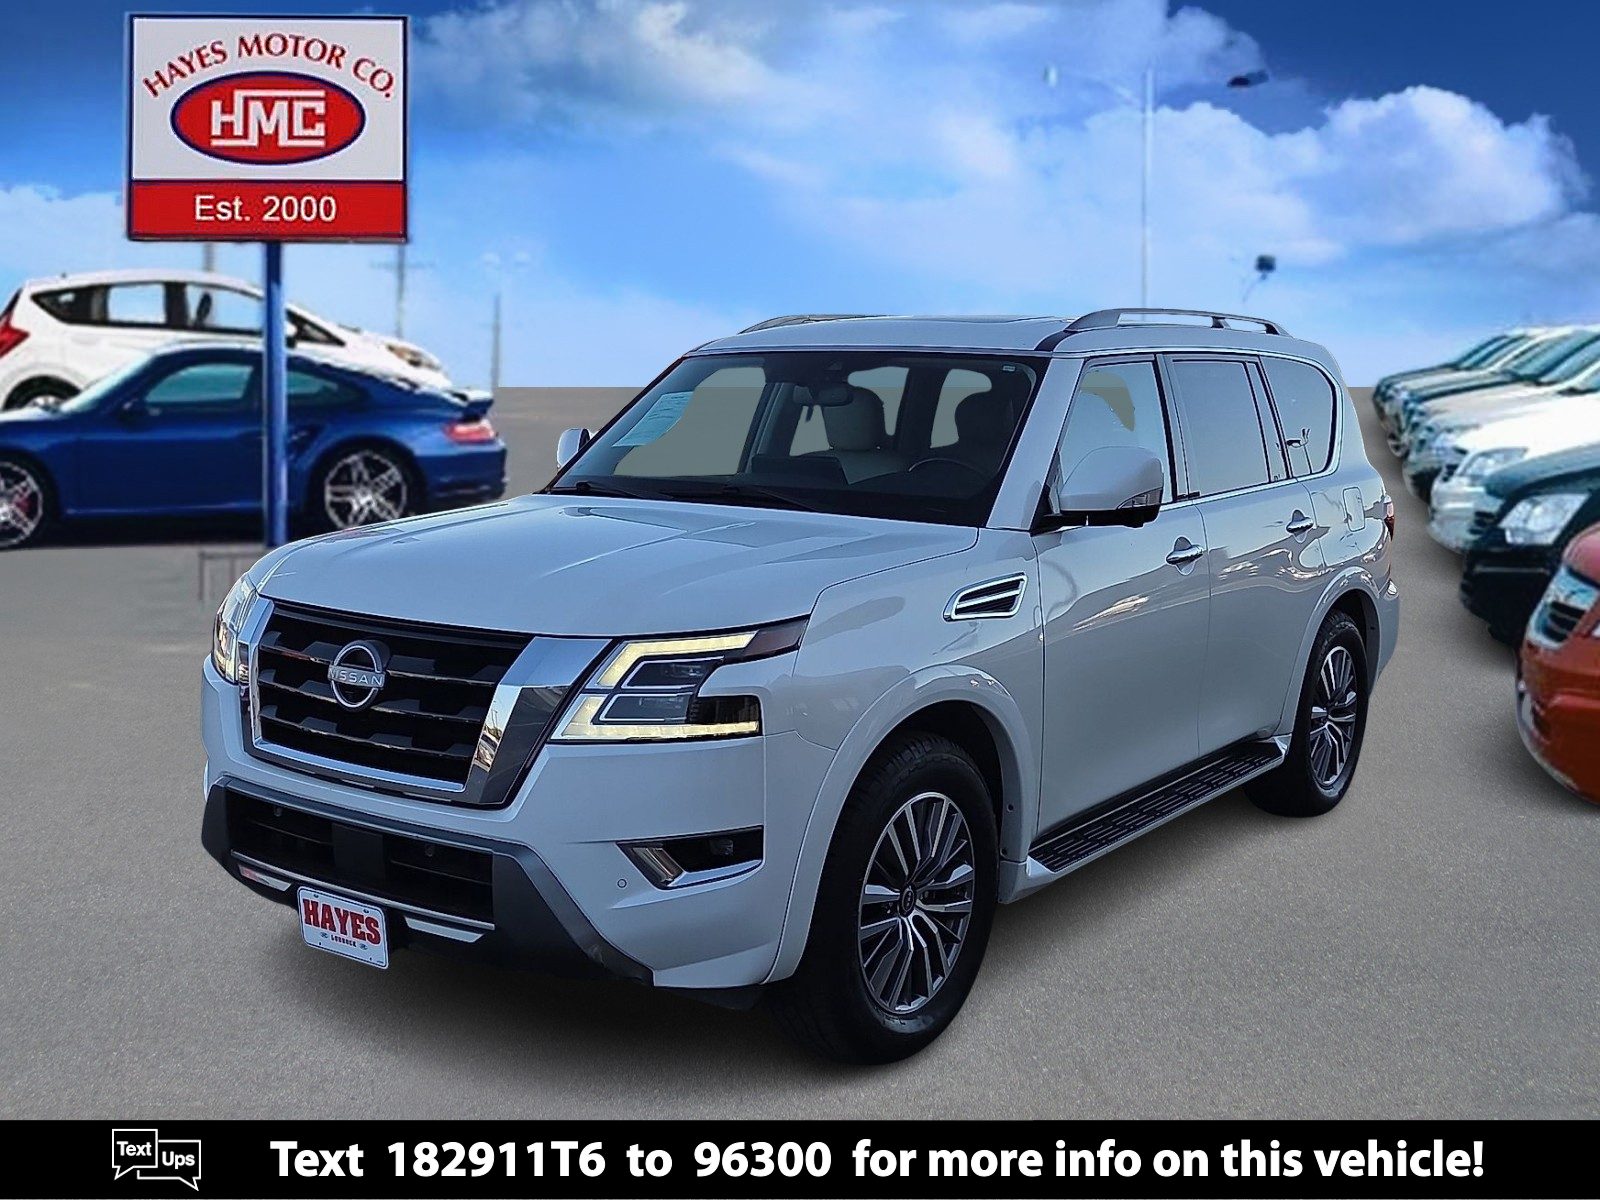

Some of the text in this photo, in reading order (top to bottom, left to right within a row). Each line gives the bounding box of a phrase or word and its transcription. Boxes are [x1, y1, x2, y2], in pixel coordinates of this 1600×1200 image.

[142, 32, 395, 99] HAYES MOTOR CO.
[210, 88, 326, 148] HMC
[194, 194, 337, 223] Est. 2000
[328, 665, 383, 687] NISSAN
[302, 898, 381, 945] HAYES
